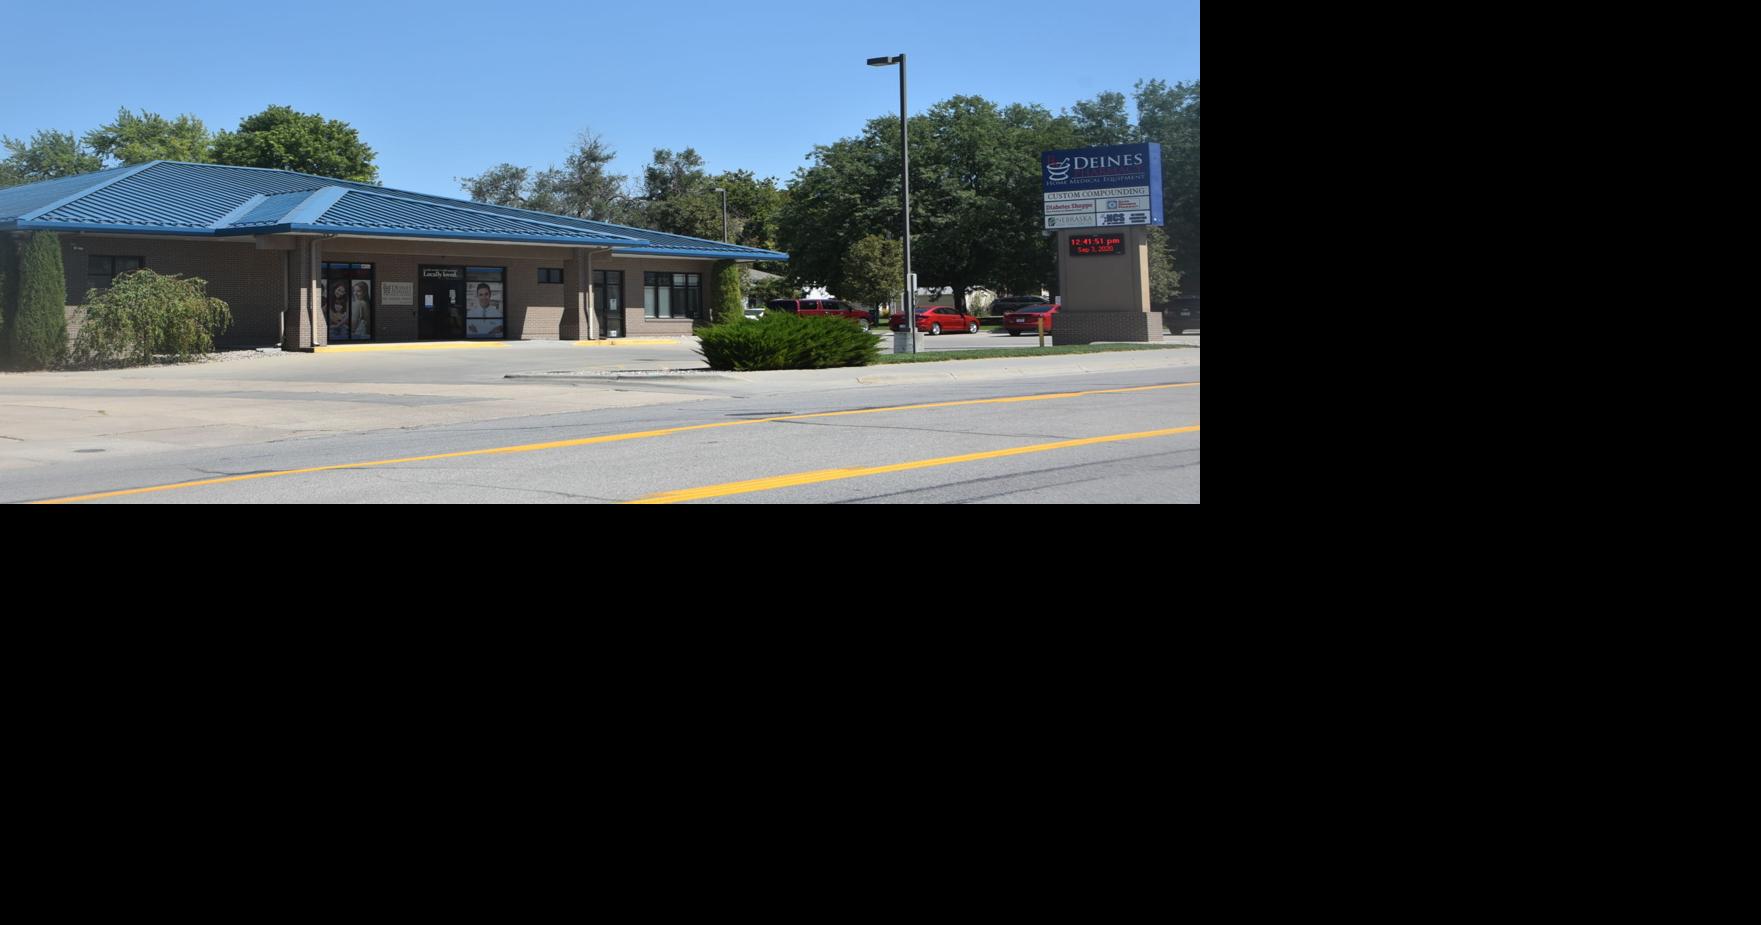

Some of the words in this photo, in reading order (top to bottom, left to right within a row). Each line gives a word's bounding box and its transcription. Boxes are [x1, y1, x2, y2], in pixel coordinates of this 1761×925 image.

[1074, 153, 1143, 169] DEINES
[1048, 191, 1081, 199] CUSTOM
[1083, 188, 1145, 197] COMPOUNDING
